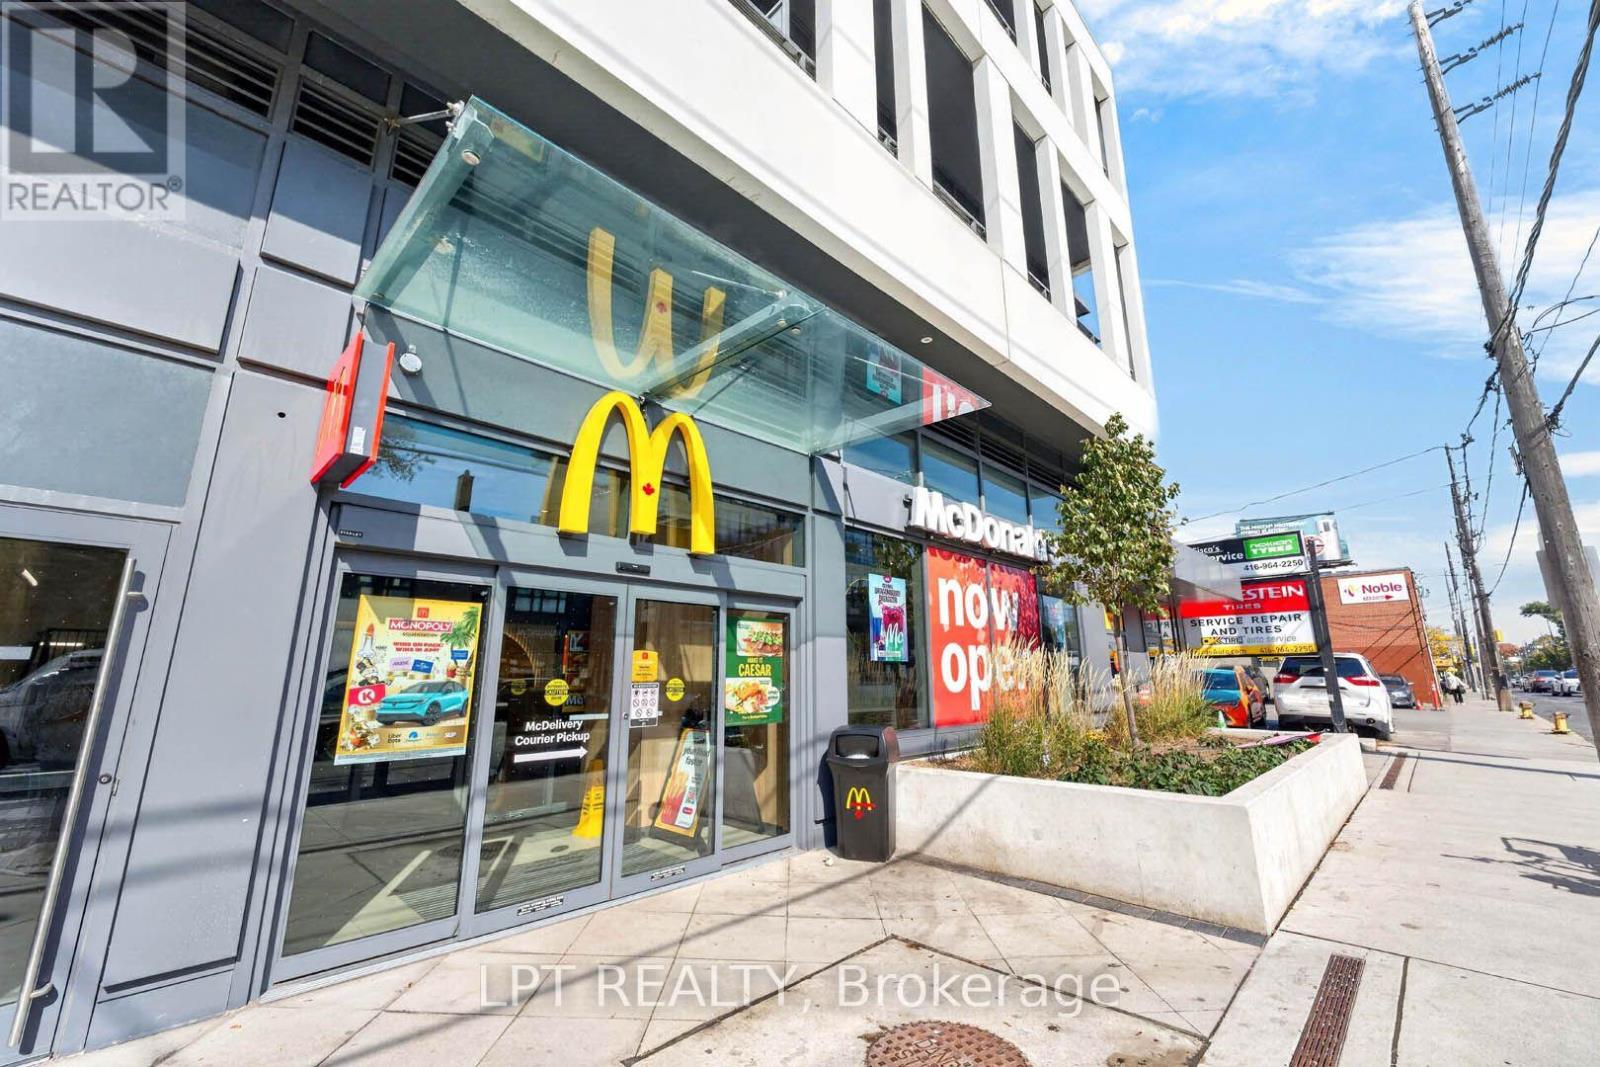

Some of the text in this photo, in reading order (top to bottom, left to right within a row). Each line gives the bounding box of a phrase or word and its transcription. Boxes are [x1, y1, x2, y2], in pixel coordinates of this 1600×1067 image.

[1205, 551, 1244, 562] ervice
[1361, 582, 1402, 594] Noble
[938, 577, 1019, 632] now
[390, 620, 452, 631] MONOPOLY
[1190, 613, 1302, 627] SERVICE REPAIR
[1211, 625, 1282, 636] AND TIRES
[1266, 634, 1297, 644] service
[738, 663, 772, 677] CAESAR
[525, 719, 583, 731] McDelivery
[515, 731, 590, 746] Courier Pickup
